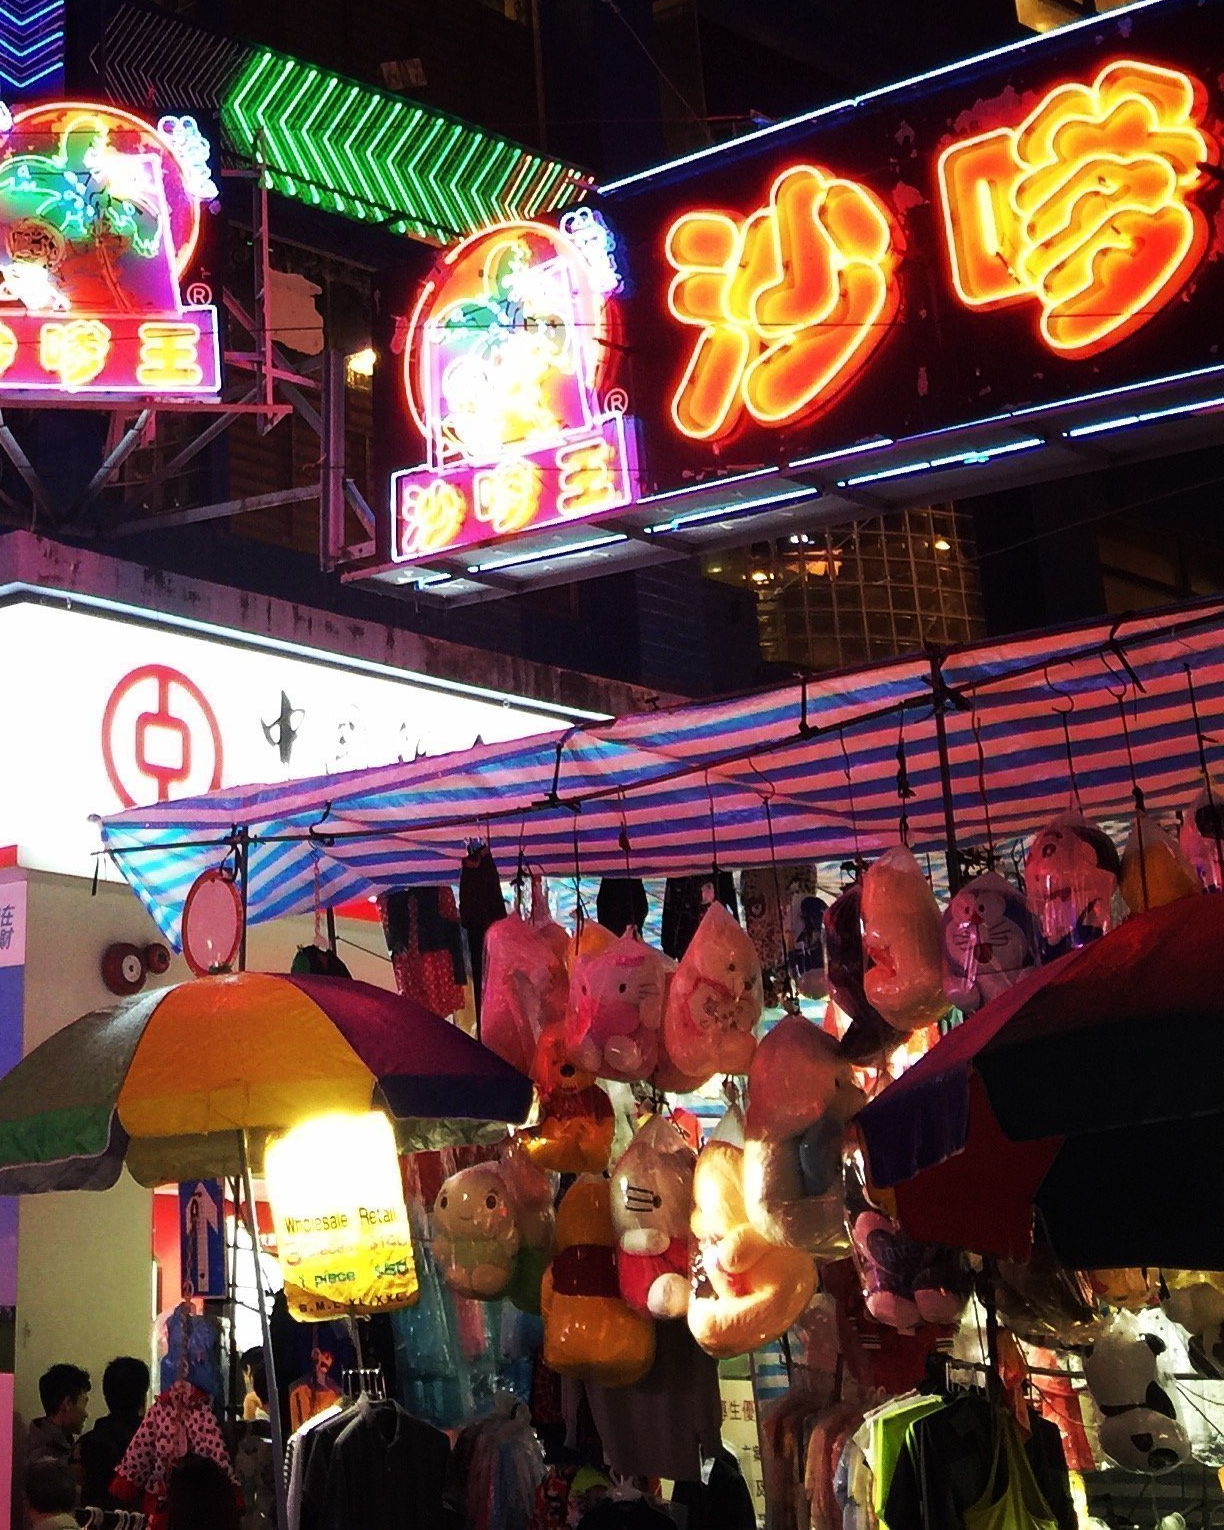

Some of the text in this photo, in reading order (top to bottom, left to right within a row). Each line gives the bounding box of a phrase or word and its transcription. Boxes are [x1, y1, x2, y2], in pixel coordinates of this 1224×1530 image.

[664, 58, 1216, 442] 沙嗲
[283, 1206, 397, 1234] Wholesale Retail
